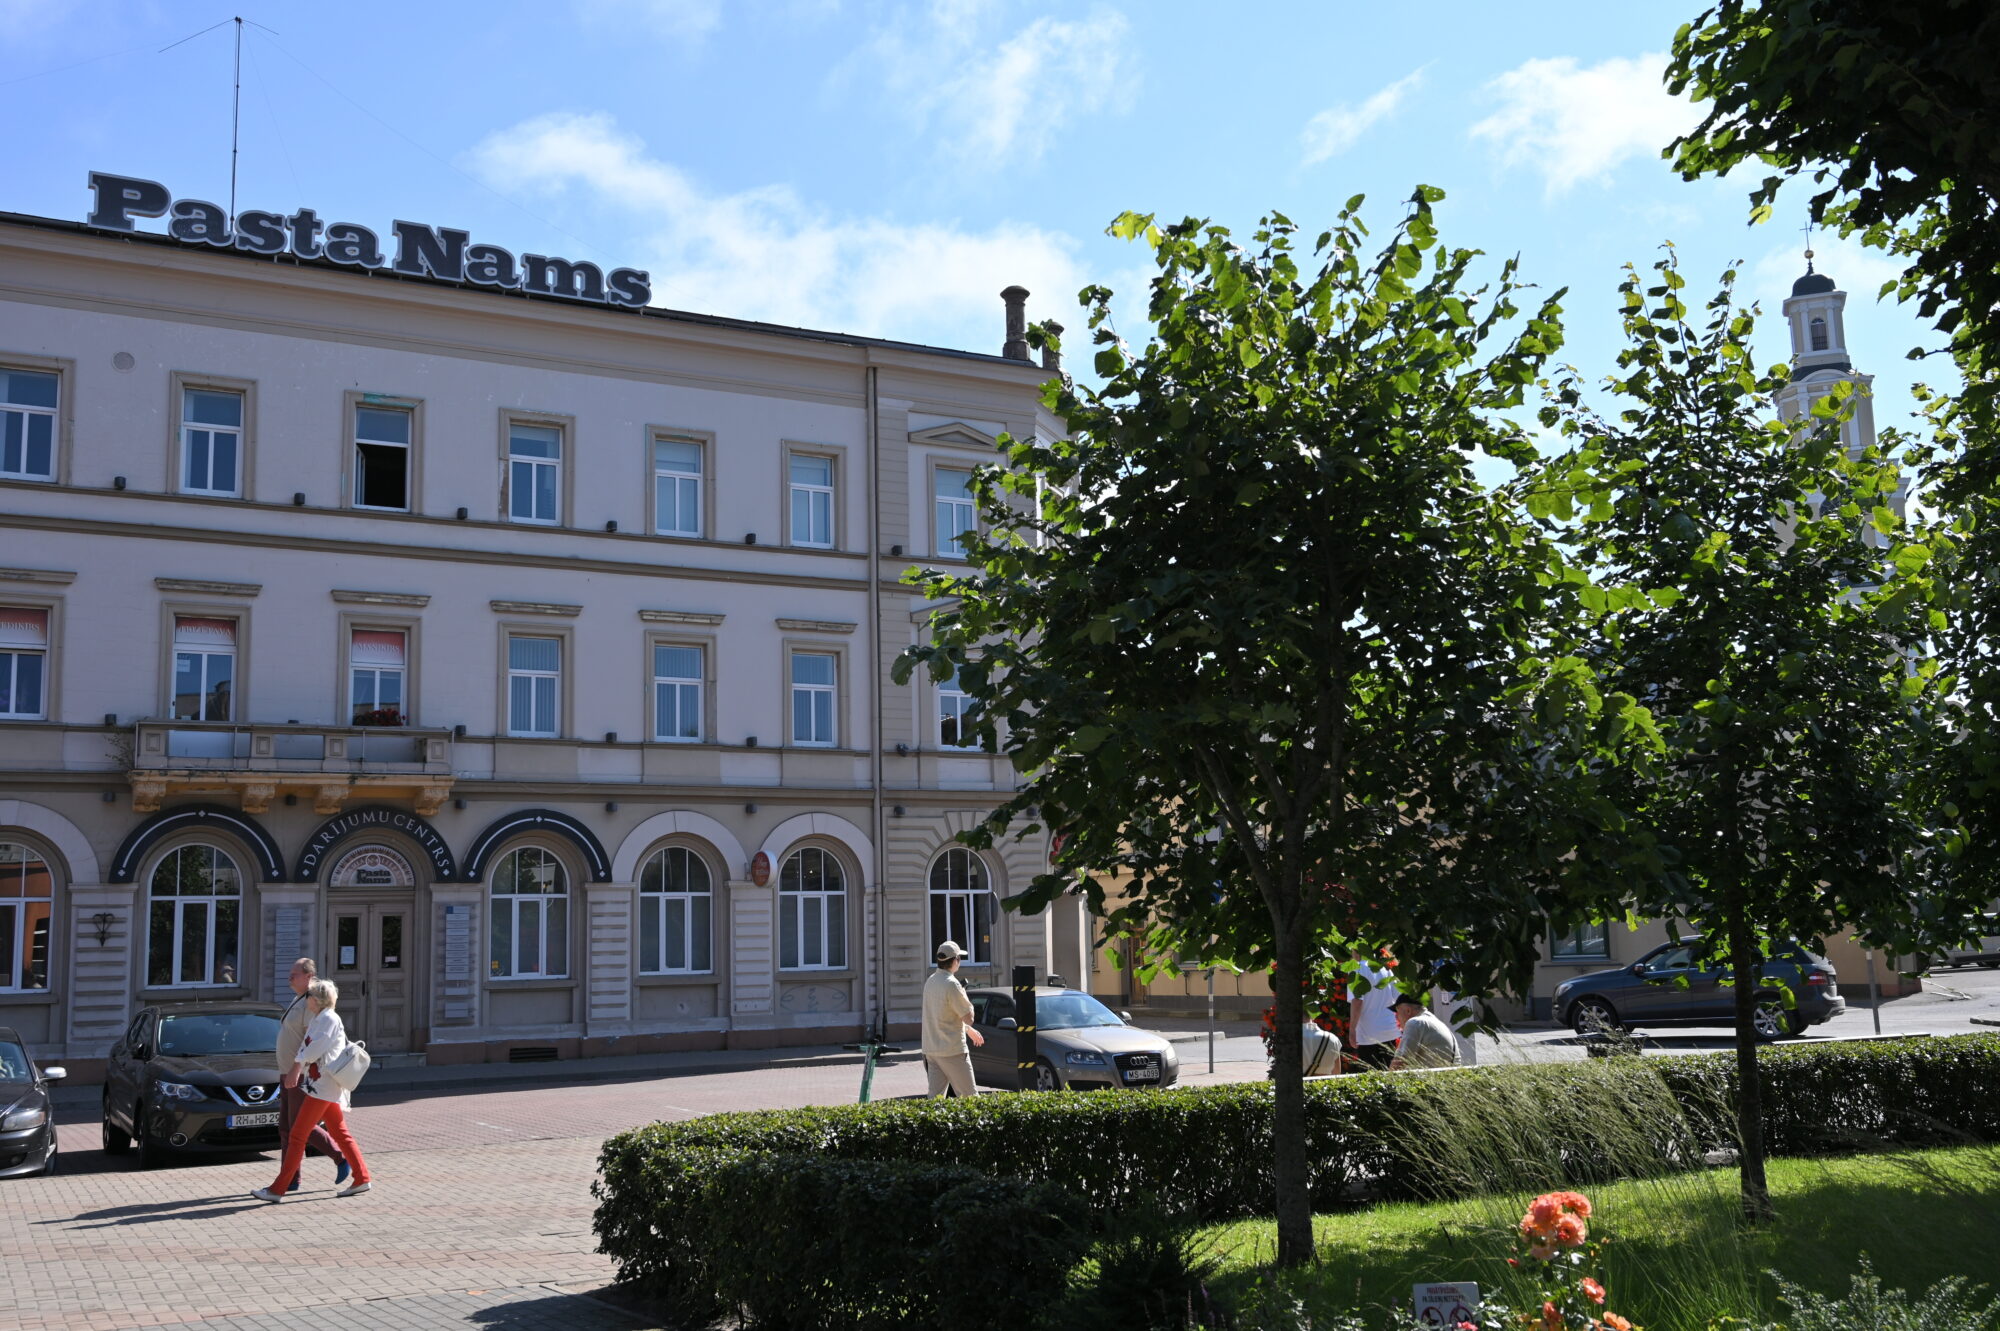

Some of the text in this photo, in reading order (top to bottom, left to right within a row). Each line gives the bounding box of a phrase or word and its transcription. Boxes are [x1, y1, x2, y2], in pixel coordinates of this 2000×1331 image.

[88, 170, 652, 308] Pasta Nams
[304, 811, 450, 868] DARĪJUMU CENTRS
[235, 1116, 249, 1125] RH
[255, 1114, 268, 1124] HB
